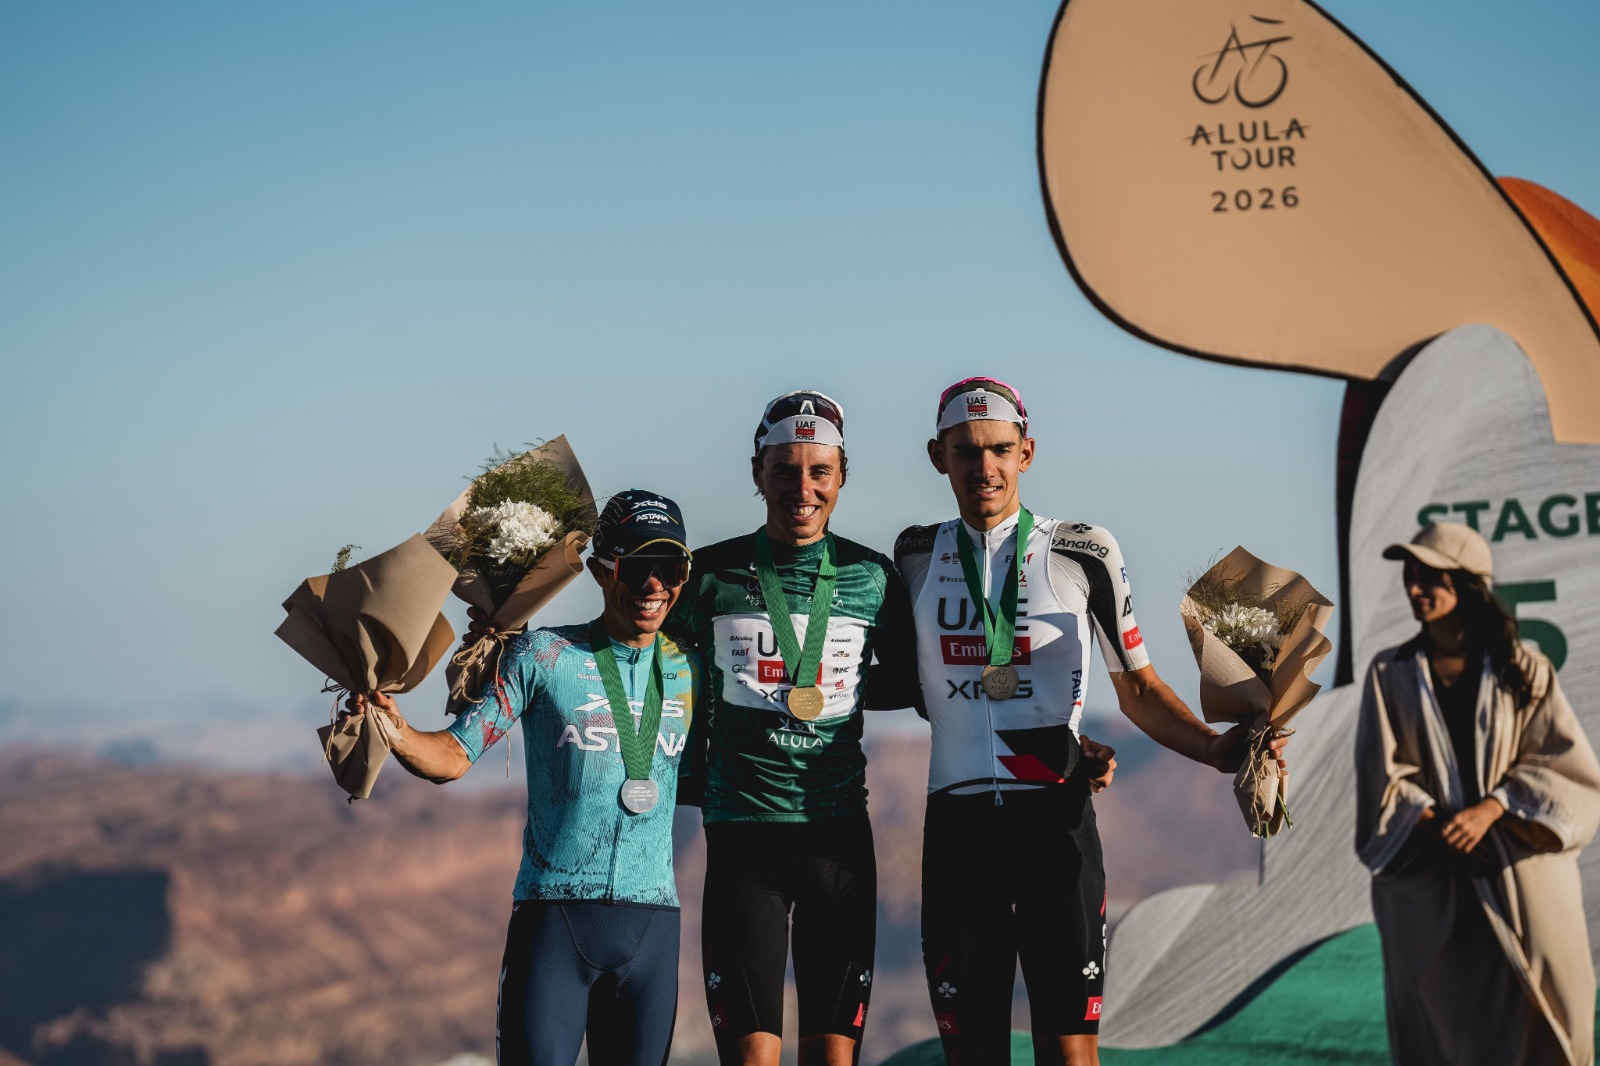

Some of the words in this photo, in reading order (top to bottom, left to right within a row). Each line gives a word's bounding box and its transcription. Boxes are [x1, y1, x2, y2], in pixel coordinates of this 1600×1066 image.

[1184, 118, 1312, 146] ALULA
[1211, 147, 1296, 172] TOUR
[1211, 186, 1299, 213] 2026
[967, 396, 987, 405] UAE
[796, 420, 816, 428] UAE
[635, 513, 670, 523] ASTANA
[1055, 538, 1110, 558] Analog
[577, 672, 602, 682] SHIM
[556, 724, 686, 757] ASTNA
[767, 732, 824, 749] ALULA
